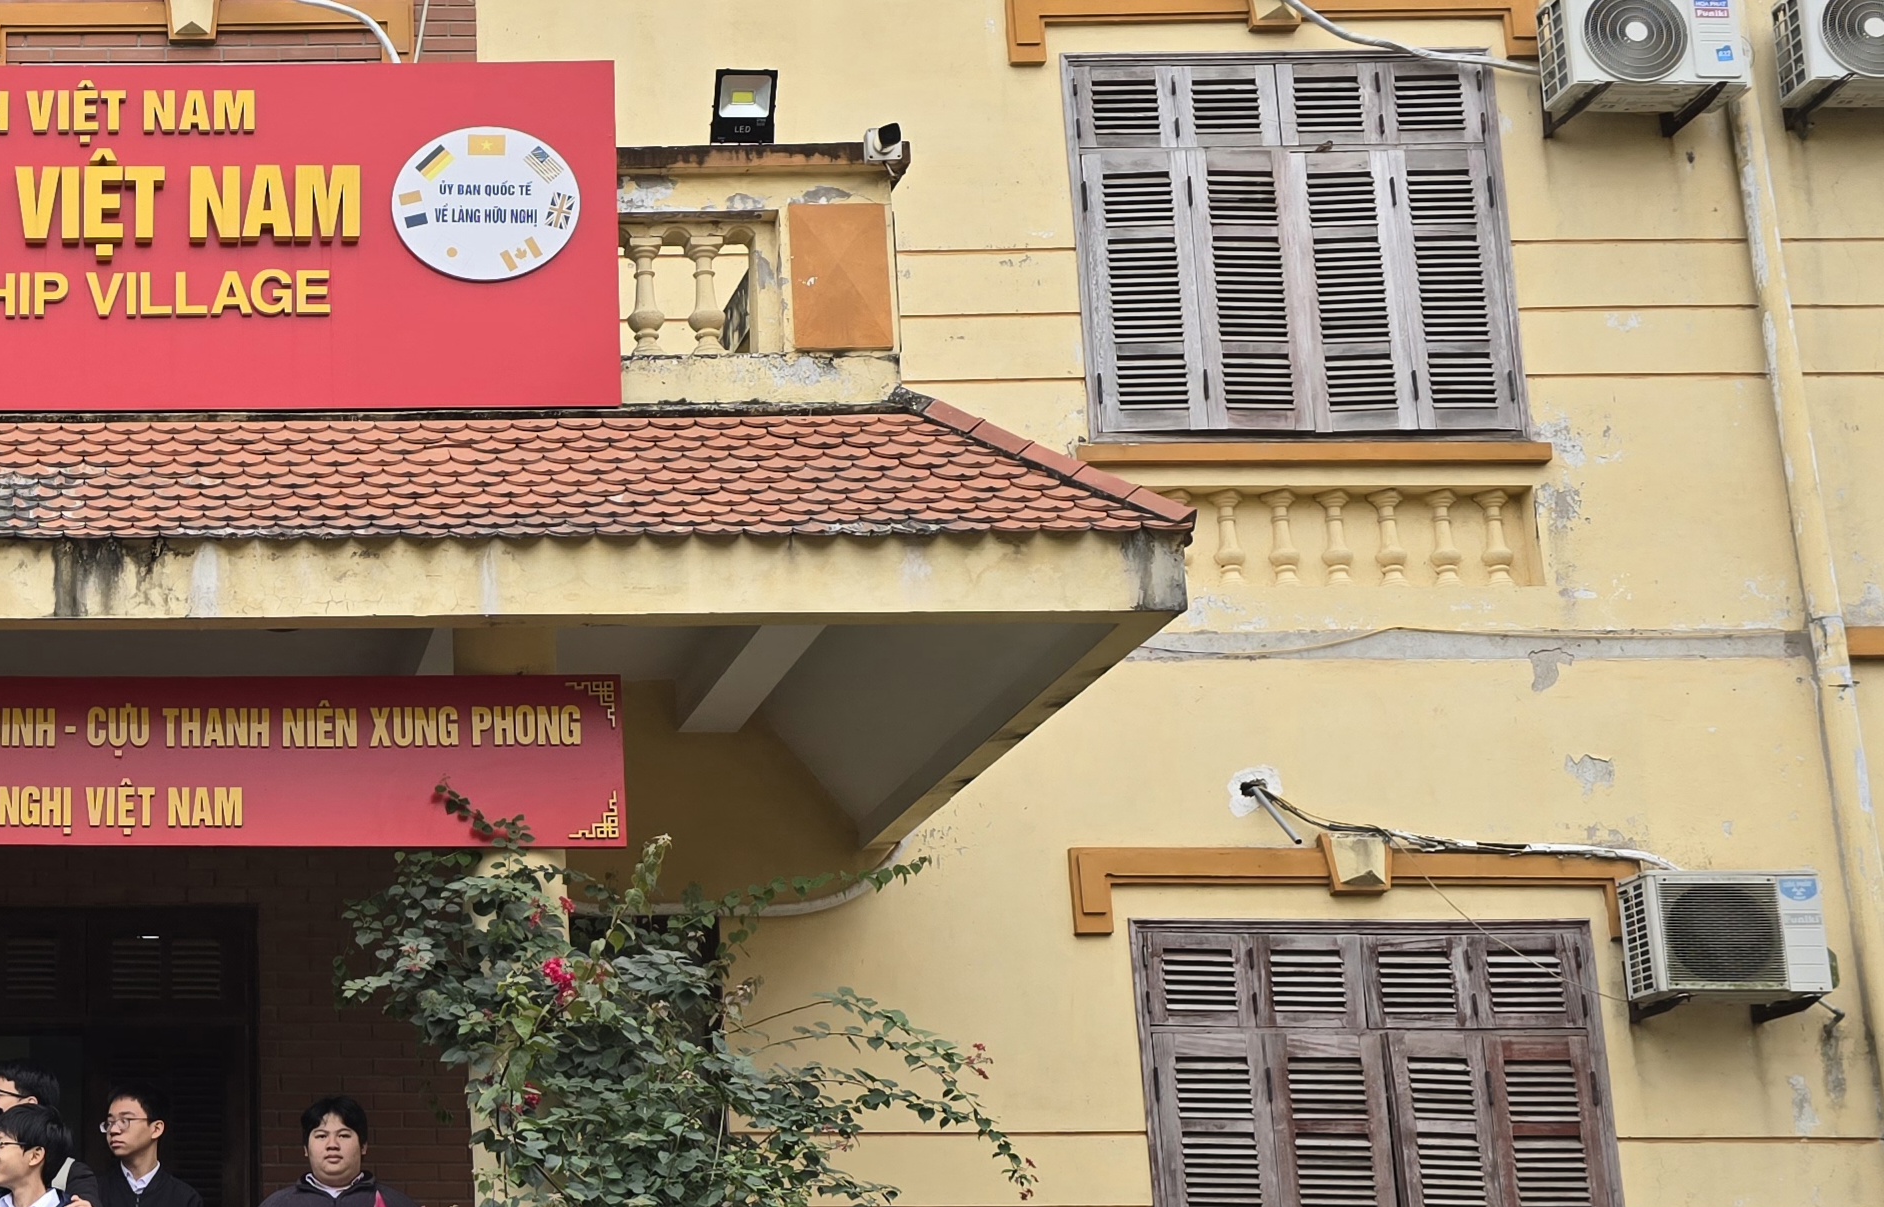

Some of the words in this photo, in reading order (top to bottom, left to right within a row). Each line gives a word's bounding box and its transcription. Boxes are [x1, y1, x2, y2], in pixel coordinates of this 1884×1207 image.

[26, 79, 128, 145] VIỆT
[143, 89, 257, 134] NAM
[734, 125, 752, 134] LED
[15, 147, 167, 262] VIỆT
[189, 164, 363, 245] NAM
[457, 184, 482, 196] BAN
[484, 180, 516, 197] QUỐC
[518, 181, 533, 196] TẾ
[451, 205, 481, 223] LÀNG
[484, 206, 508, 224] HỮU
[510, 208, 538, 227] NGHỊ
[86, 268, 333, 318] VILLAGE
[87, 702, 151, 758] CỰU
[163, 707, 271, 749] THANH
[282, 700, 359, 749] NIÊN
[370, 706, 460, 749] XUNG
[472, 705, 583, 748] PHONG
[85, 777, 156, 836] VIỆT
[167, 786, 244, 828] NAM
